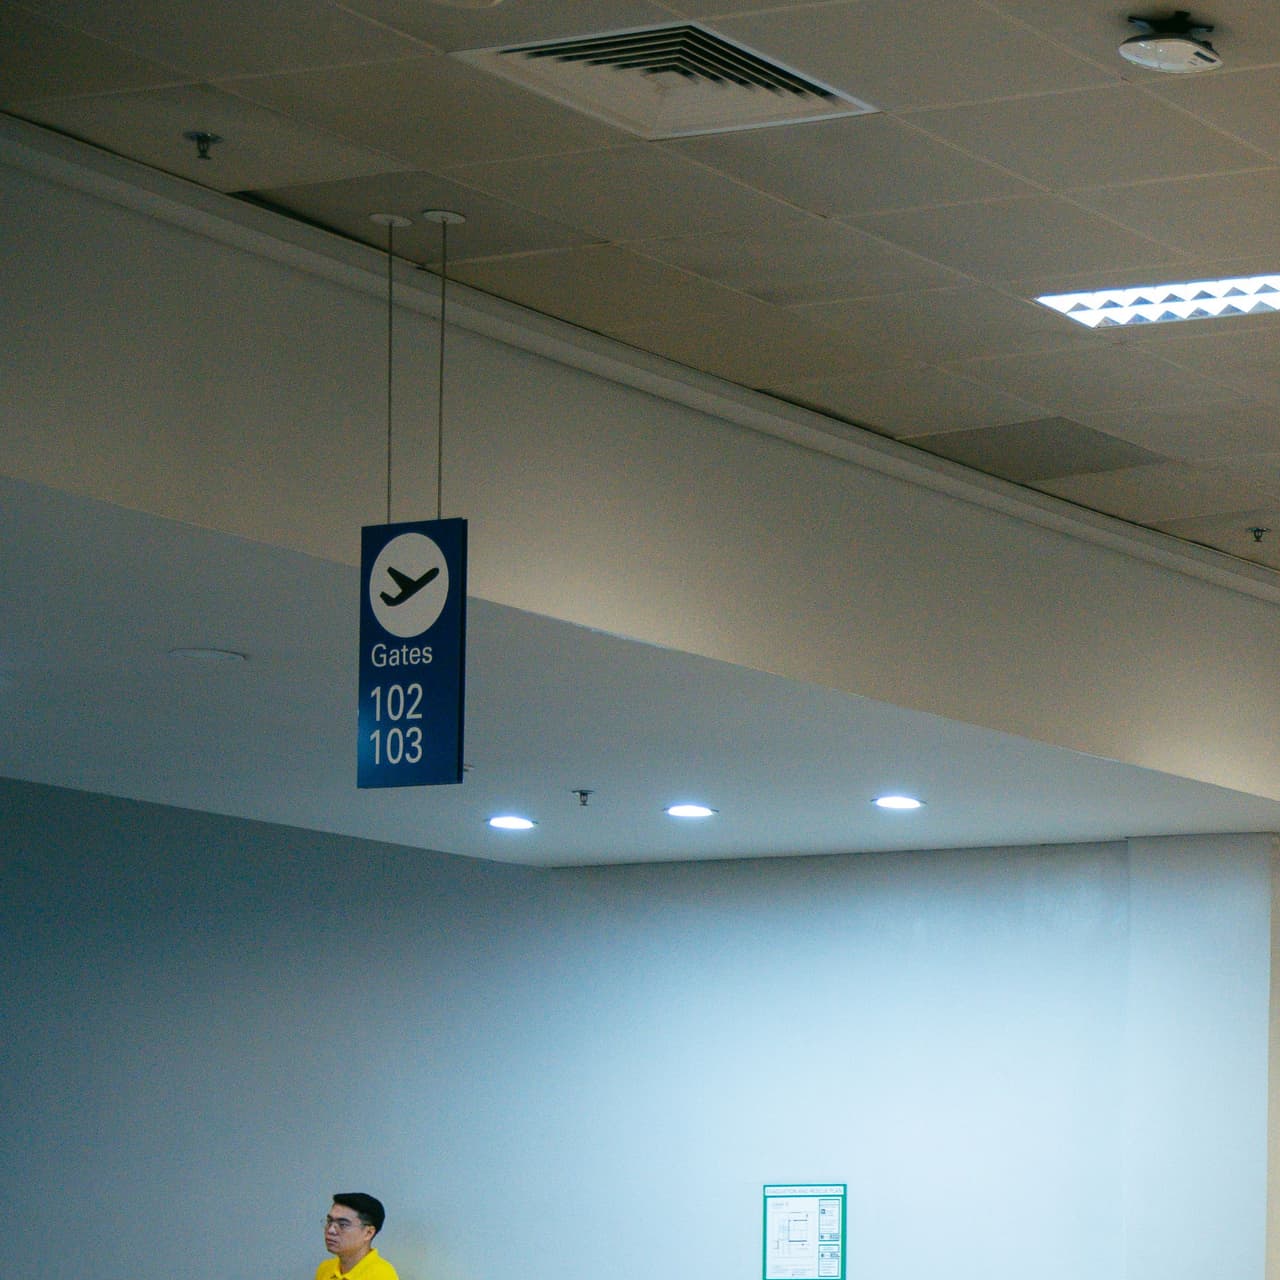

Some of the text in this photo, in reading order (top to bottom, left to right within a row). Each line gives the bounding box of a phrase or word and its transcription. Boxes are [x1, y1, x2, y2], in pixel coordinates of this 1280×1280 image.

[371, 643, 433, 668] Gates
[370, 683, 423, 722] 102
[370, 726, 423, 765] 103
